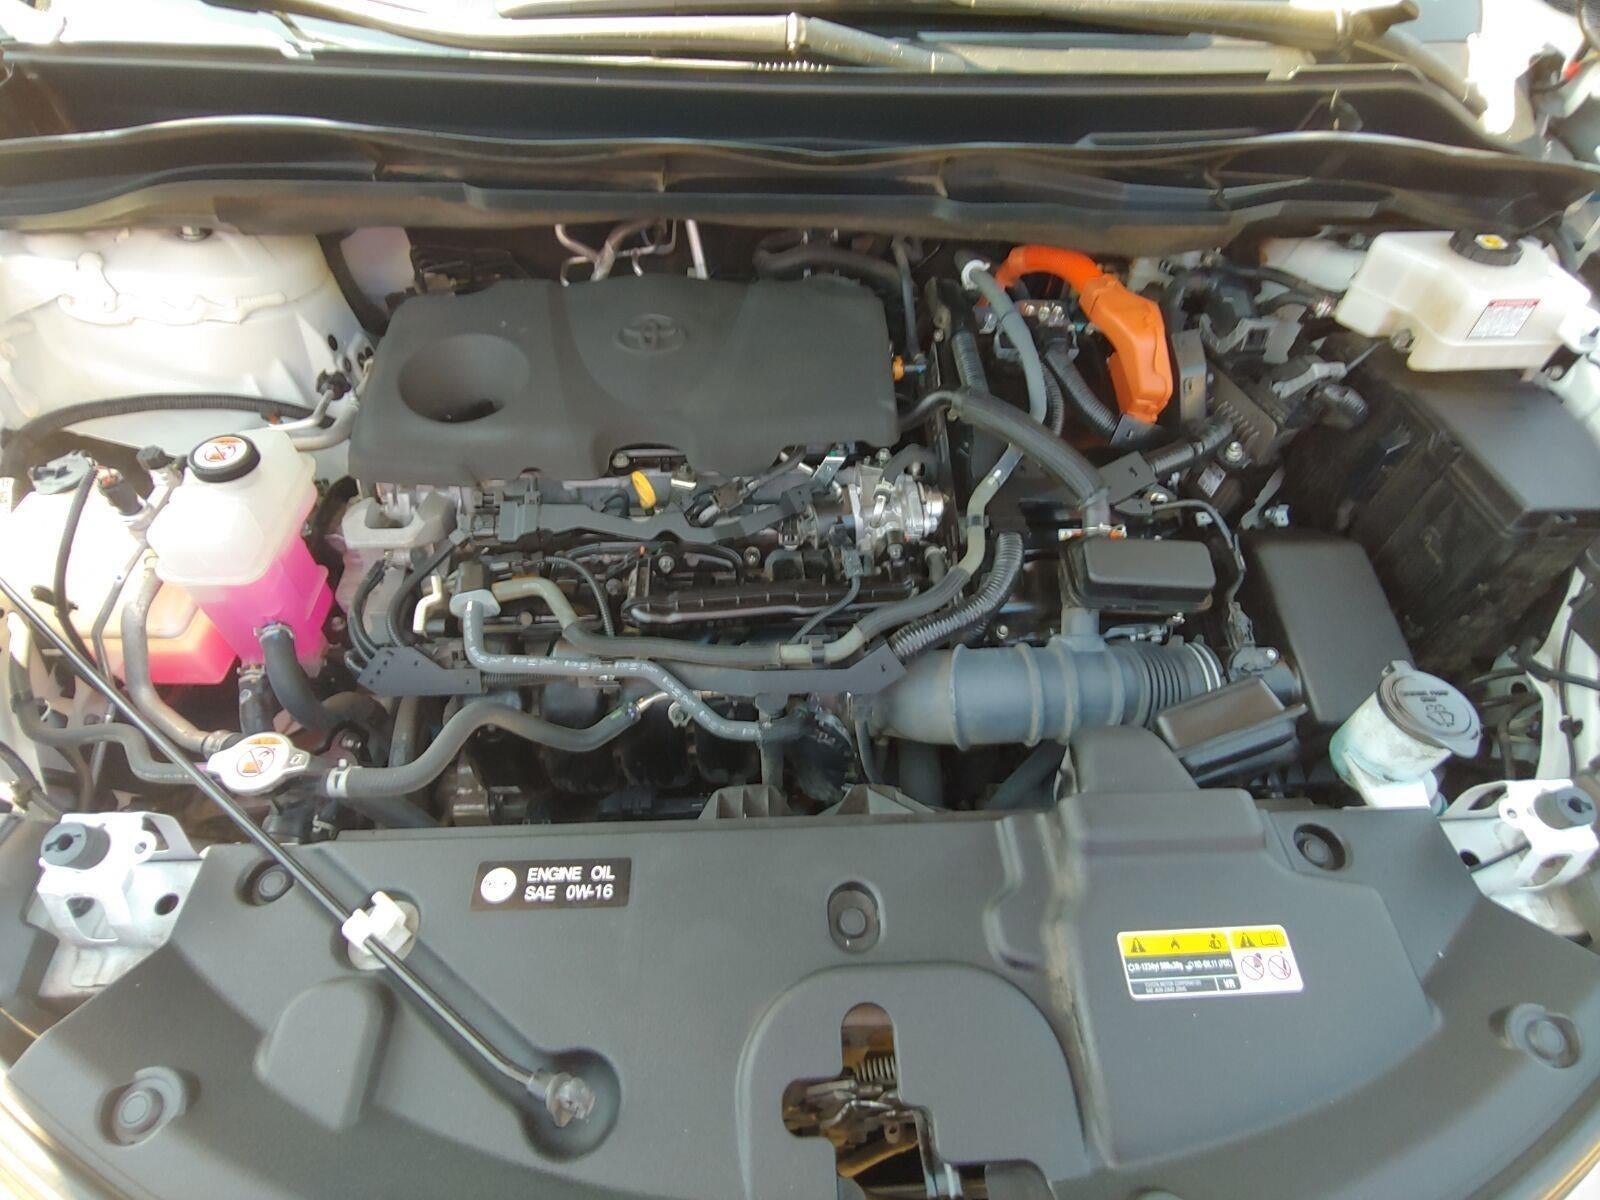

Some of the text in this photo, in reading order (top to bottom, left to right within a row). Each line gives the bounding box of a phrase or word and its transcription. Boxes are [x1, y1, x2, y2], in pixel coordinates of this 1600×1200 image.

[526, 865, 616, 882] ENGINE OIL
[524, 884, 614, 901] SAE 0W-16
